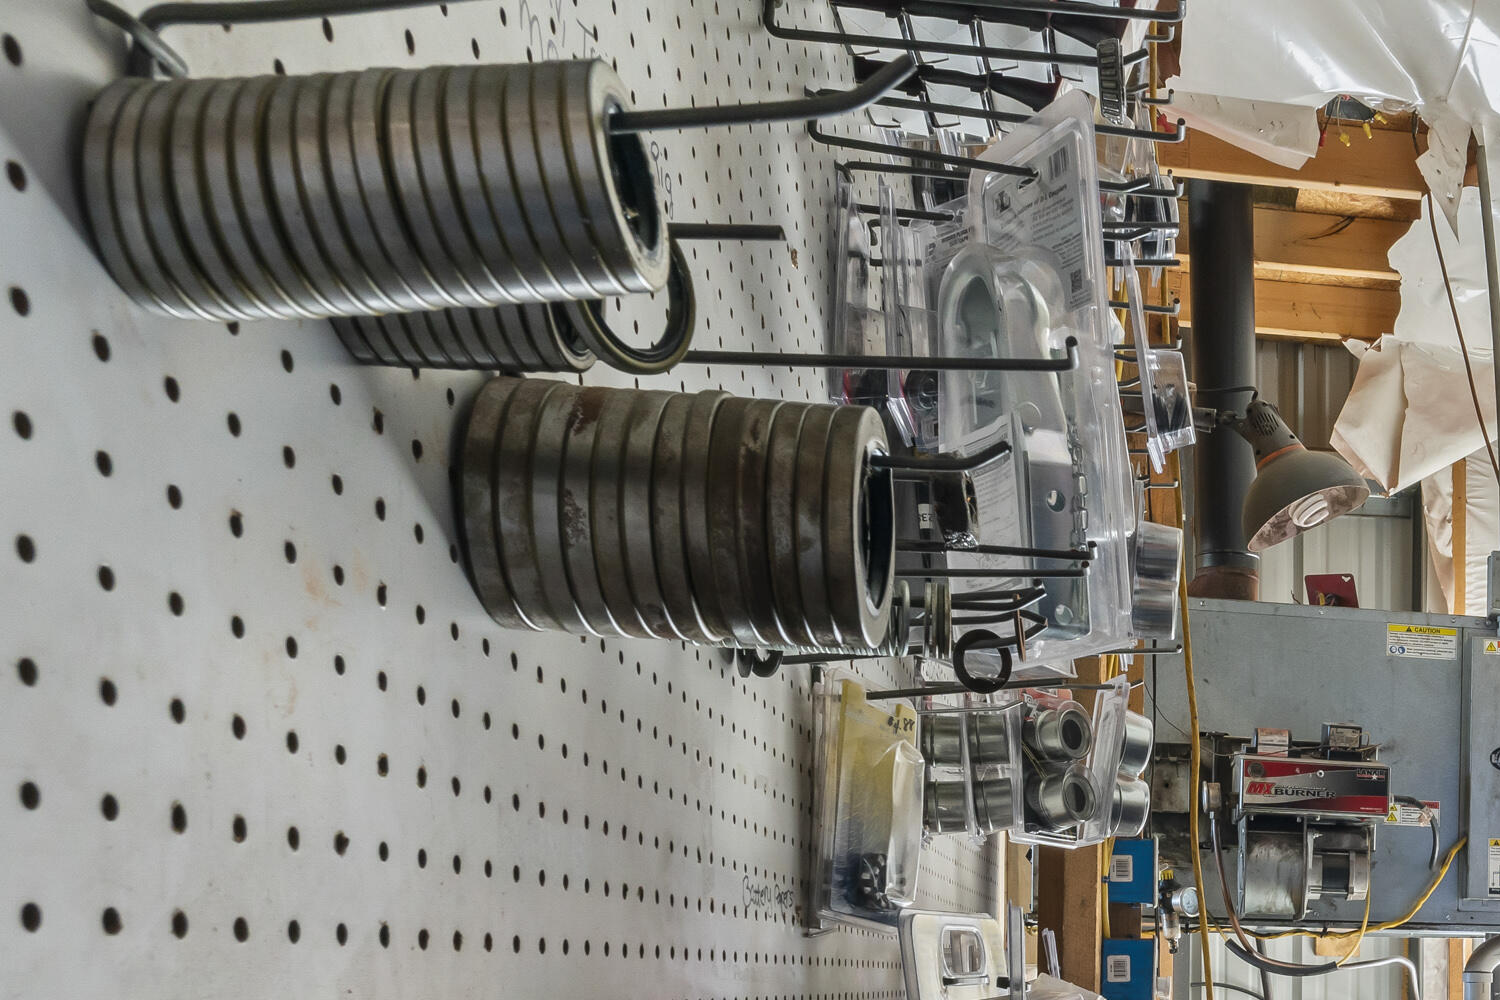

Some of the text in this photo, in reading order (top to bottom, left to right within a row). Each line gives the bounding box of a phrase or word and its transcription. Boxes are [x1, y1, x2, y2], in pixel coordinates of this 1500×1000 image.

[1414, 626, 1441, 634] CAUTION
[1246, 781, 1276, 794] MX
[1274, 788, 1336, 798] BURNER
[742, 874, 772, 918] Battery
